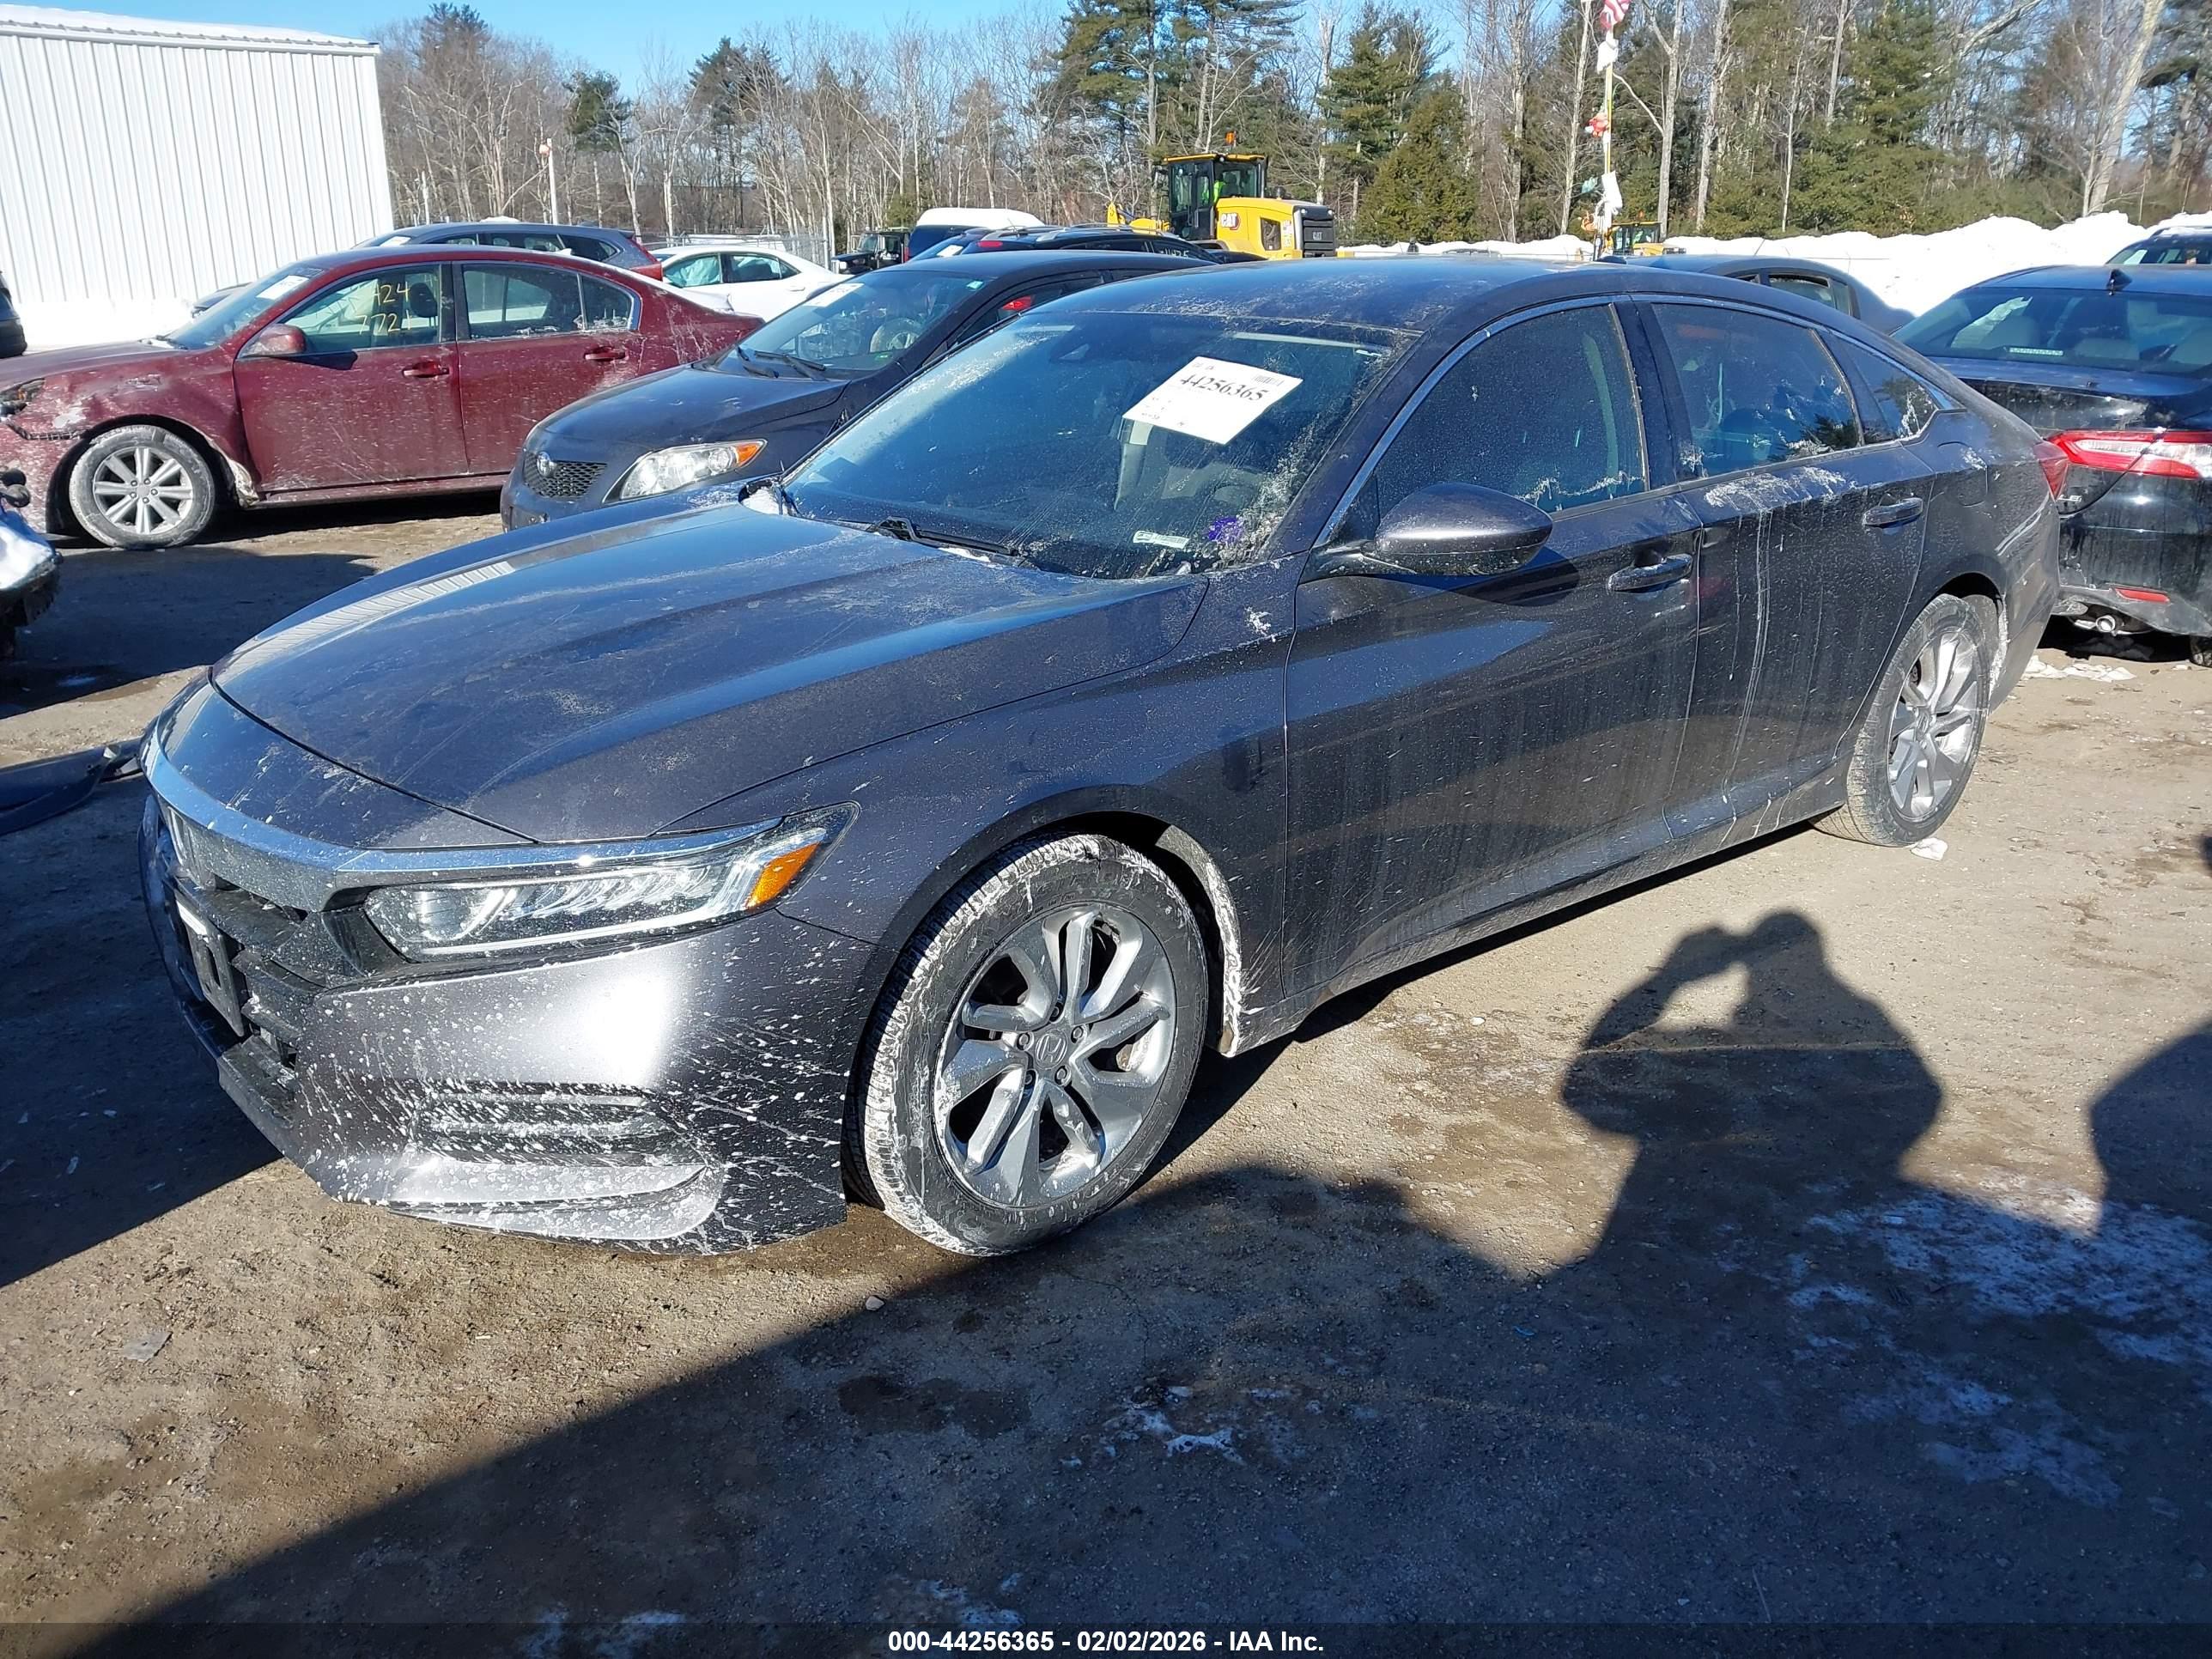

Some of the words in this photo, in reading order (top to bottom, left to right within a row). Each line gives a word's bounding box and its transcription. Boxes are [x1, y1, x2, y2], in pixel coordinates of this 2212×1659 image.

[1221, 213, 1237, 228] CAT
[1312, 231, 1322, 240] CAT
[1180, 374, 1269, 401] 44256365
